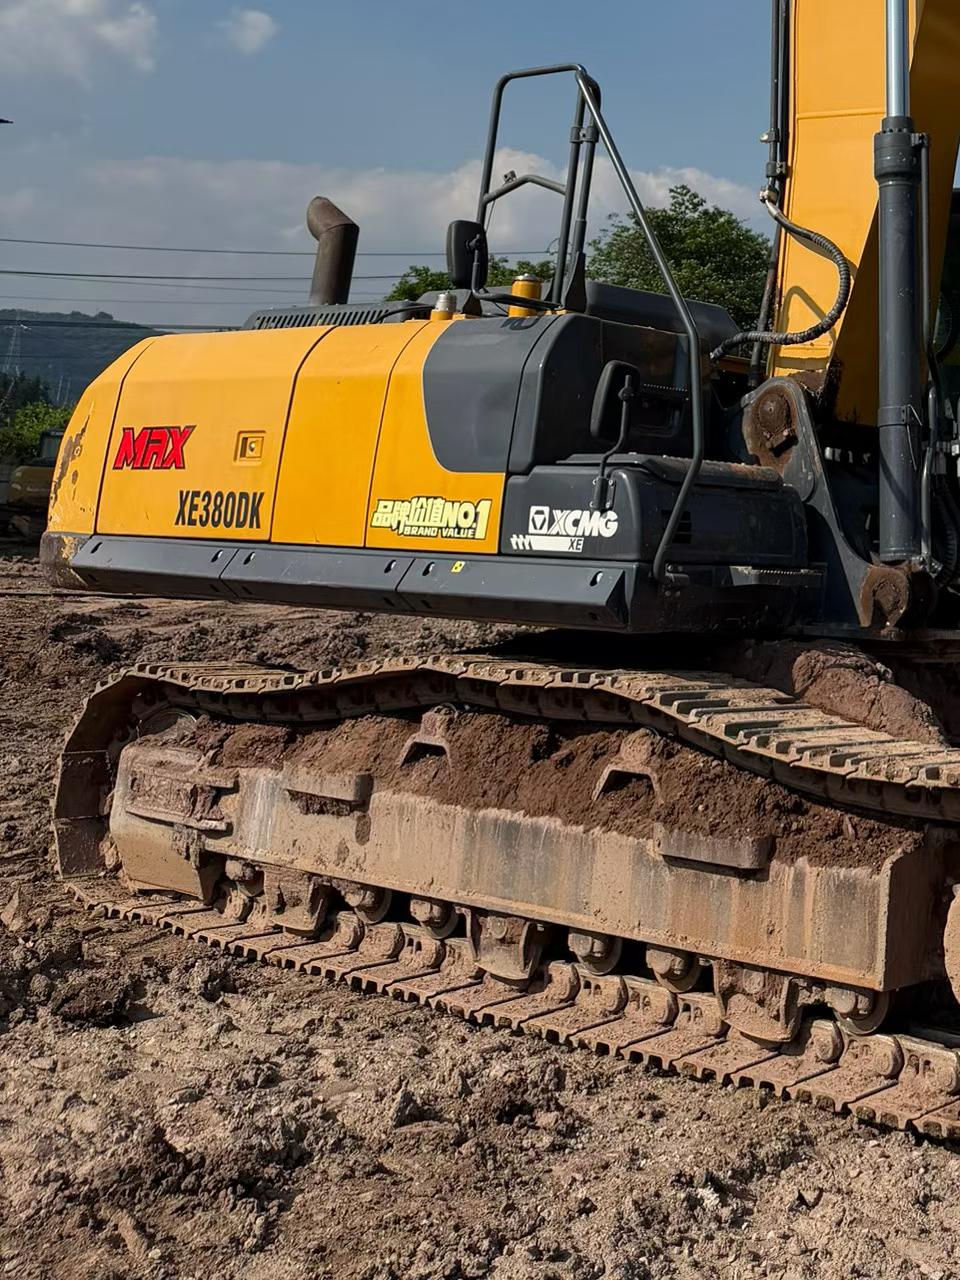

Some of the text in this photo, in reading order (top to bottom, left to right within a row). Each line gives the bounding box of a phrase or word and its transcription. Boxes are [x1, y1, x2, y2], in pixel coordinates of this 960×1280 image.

[112, 424, 197, 471] MAX
[174, 489, 264, 529] XE380DK
[547, 508, 619, 538] XCMG
[404, 527, 476, 539] BRAND VALUE
[568, 538, 583, 551] XE
